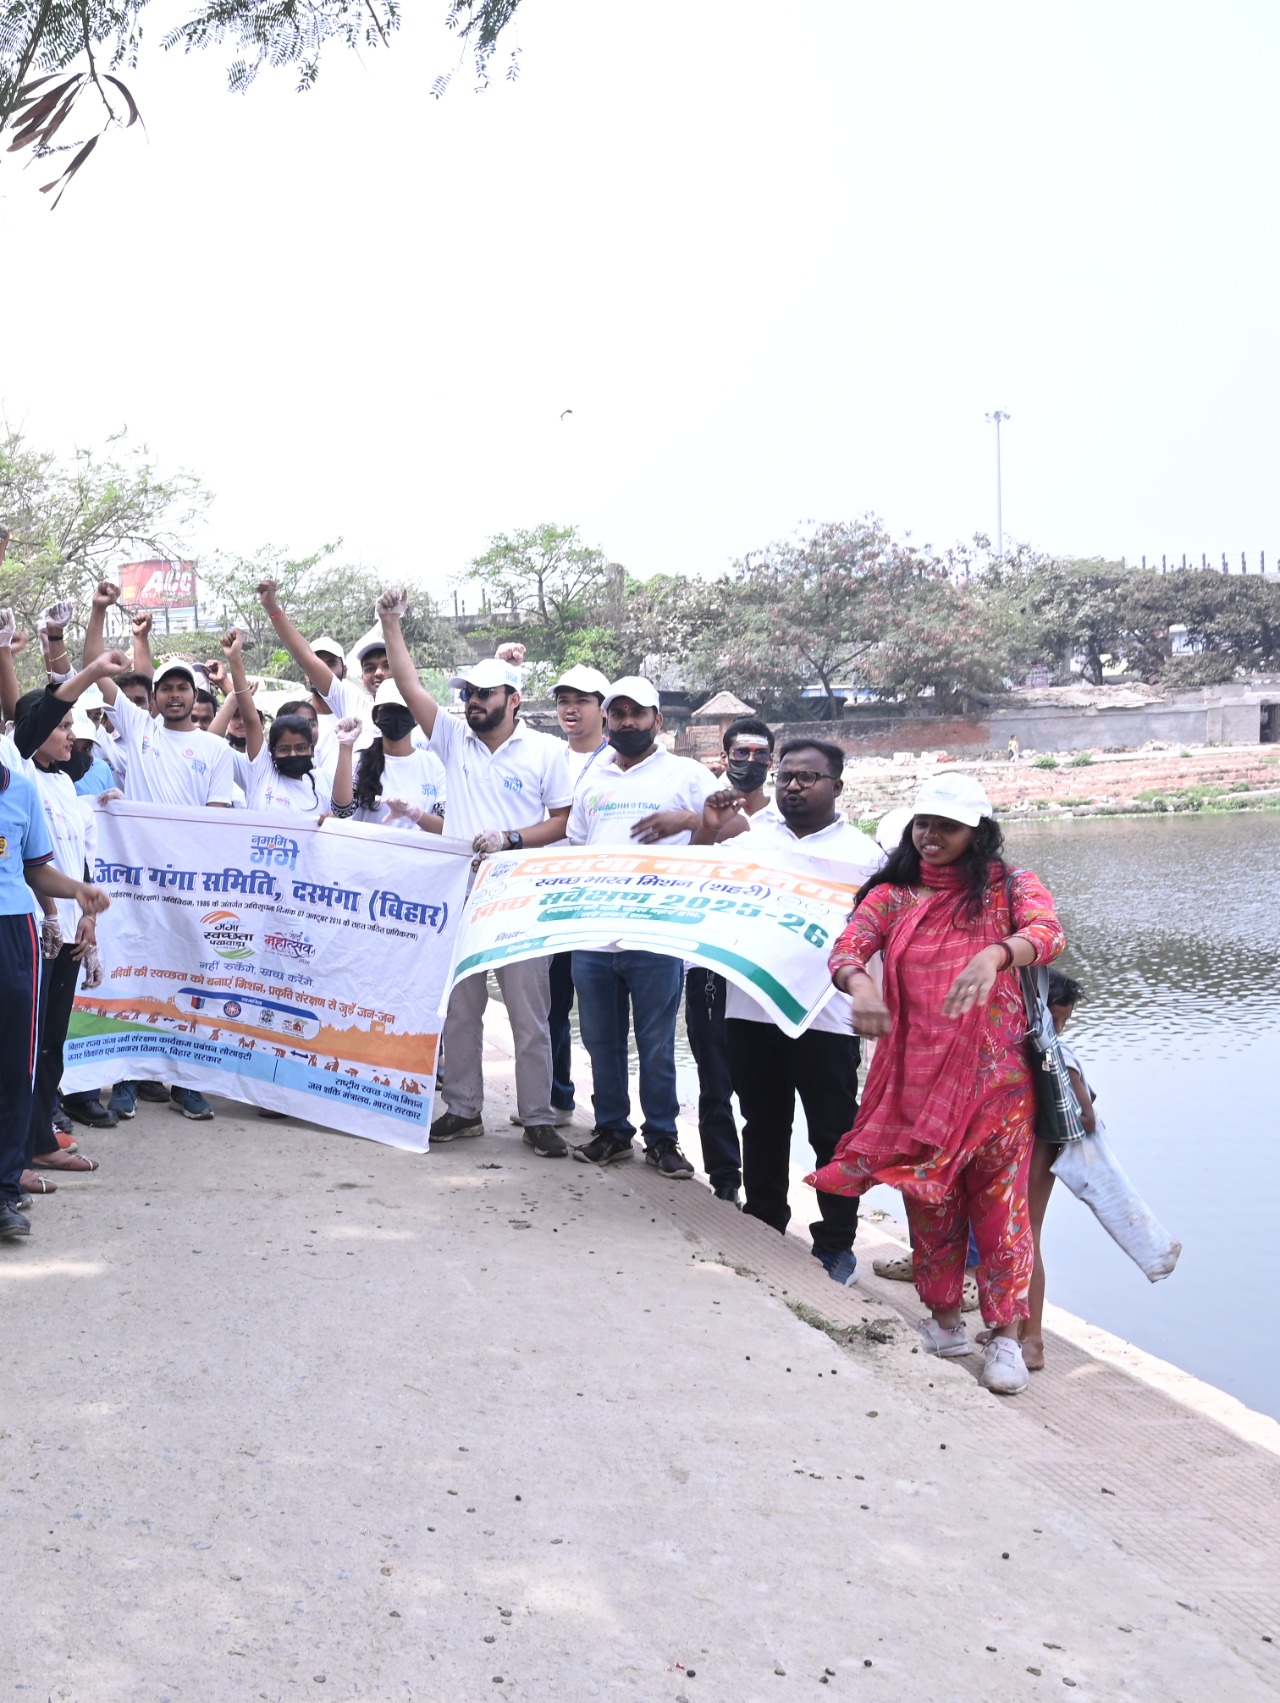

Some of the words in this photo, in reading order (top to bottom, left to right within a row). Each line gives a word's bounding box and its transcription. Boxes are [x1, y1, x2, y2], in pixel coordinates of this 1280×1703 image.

[251, 834, 288, 848] नमामि
[148, 864, 198, 891] गंगा
[201, 868, 282, 901] समिति,
[292, 880, 361, 912] दरभंगा
[369, 889, 449, 934] (बिहार)
[535, 876, 581, 888] स्वच्छ
[583, 876, 634, 886] भारत
[636, 874, 694, 888] मिशन
[699, 879, 771, 900] (शहरी)
[539, 886, 656, 906] सर्वेक्षण
[663, 892, 829, 949] 2025-26
[134, 966, 147, 978] की
[150, 968, 188, 982] स्वच्छता
[190, 973, 205, 985] को
[295, 990, 327, 1007] संरक्षण
[328, 997, 337, 1010] से
[357, 1006, 396, 1024] जन-जन
